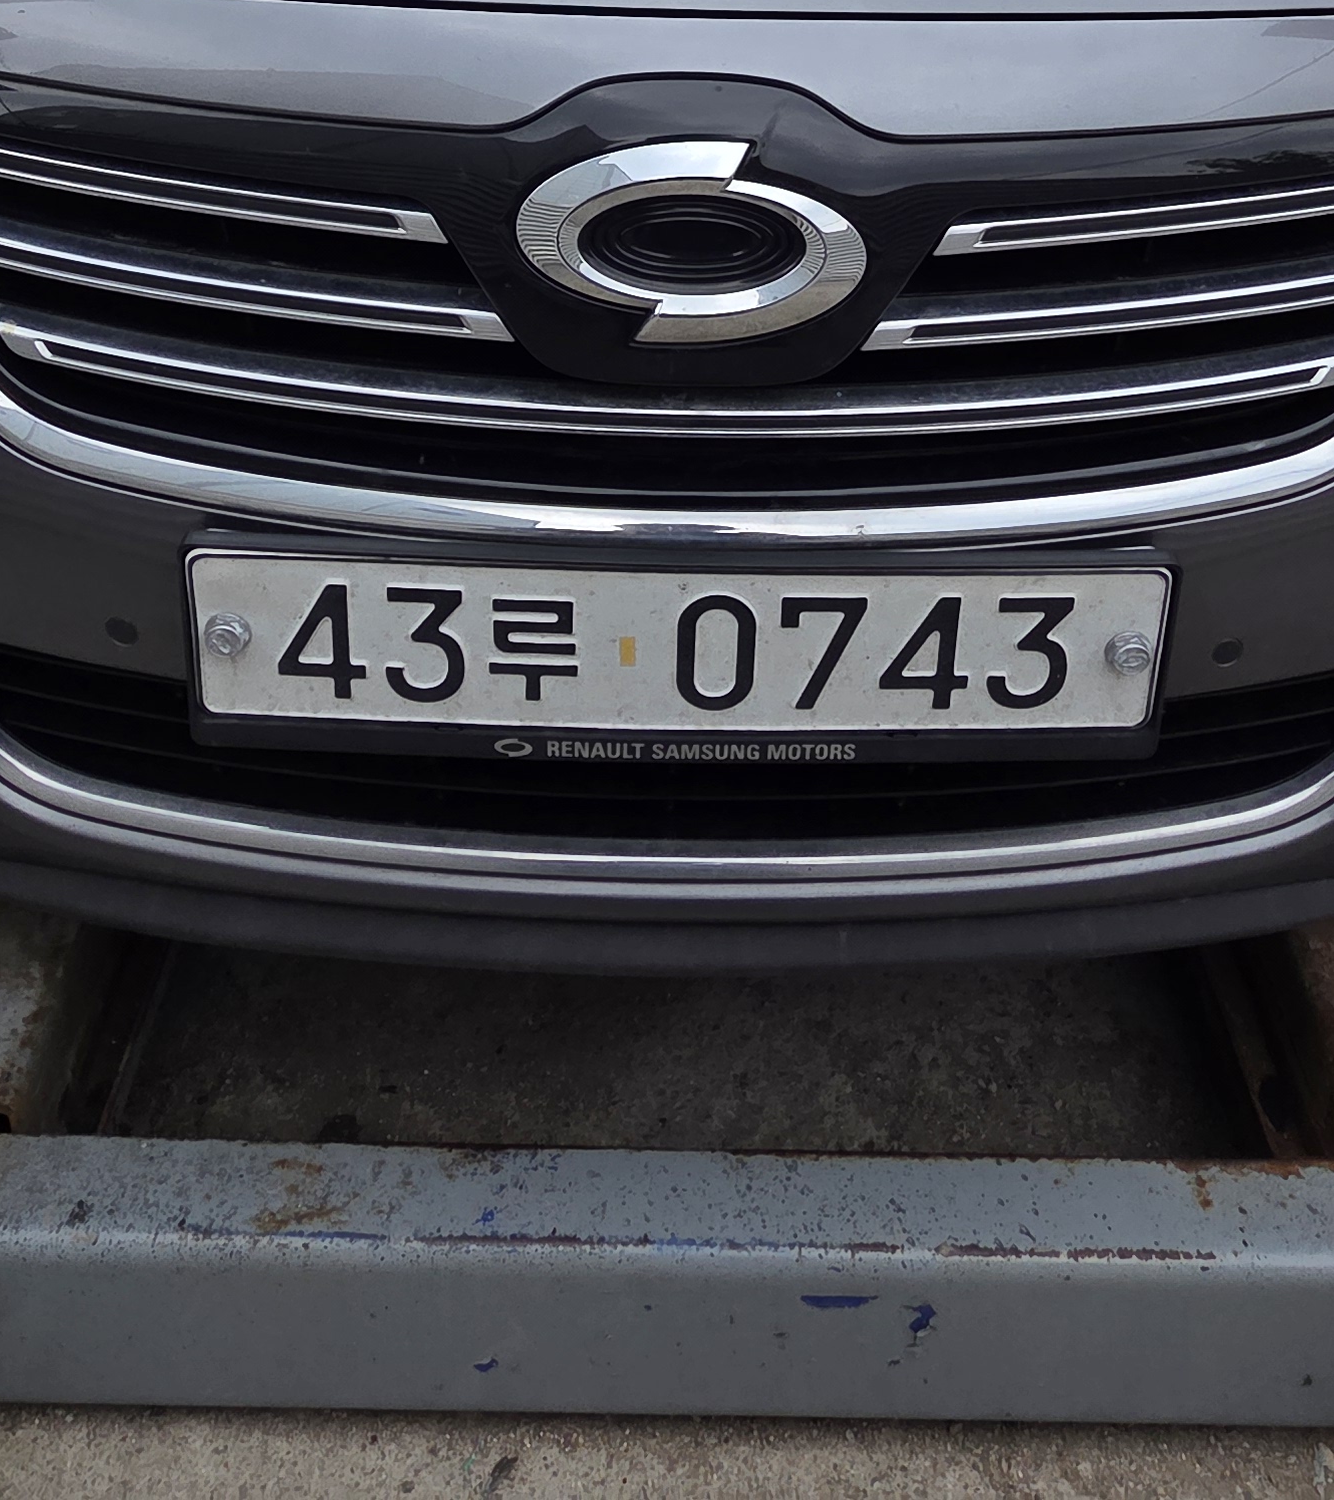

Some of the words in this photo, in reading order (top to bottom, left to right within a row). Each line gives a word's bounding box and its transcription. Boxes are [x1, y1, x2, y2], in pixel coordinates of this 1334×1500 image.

[277, 583, 579, 703] 43루
[675, 593, 1077, 711] 0743
[546, 740, 645, 760] RENAULT
[651, 743, 761, 761] SAMSUNG
[767, 744, 857, 761] MOTORS
